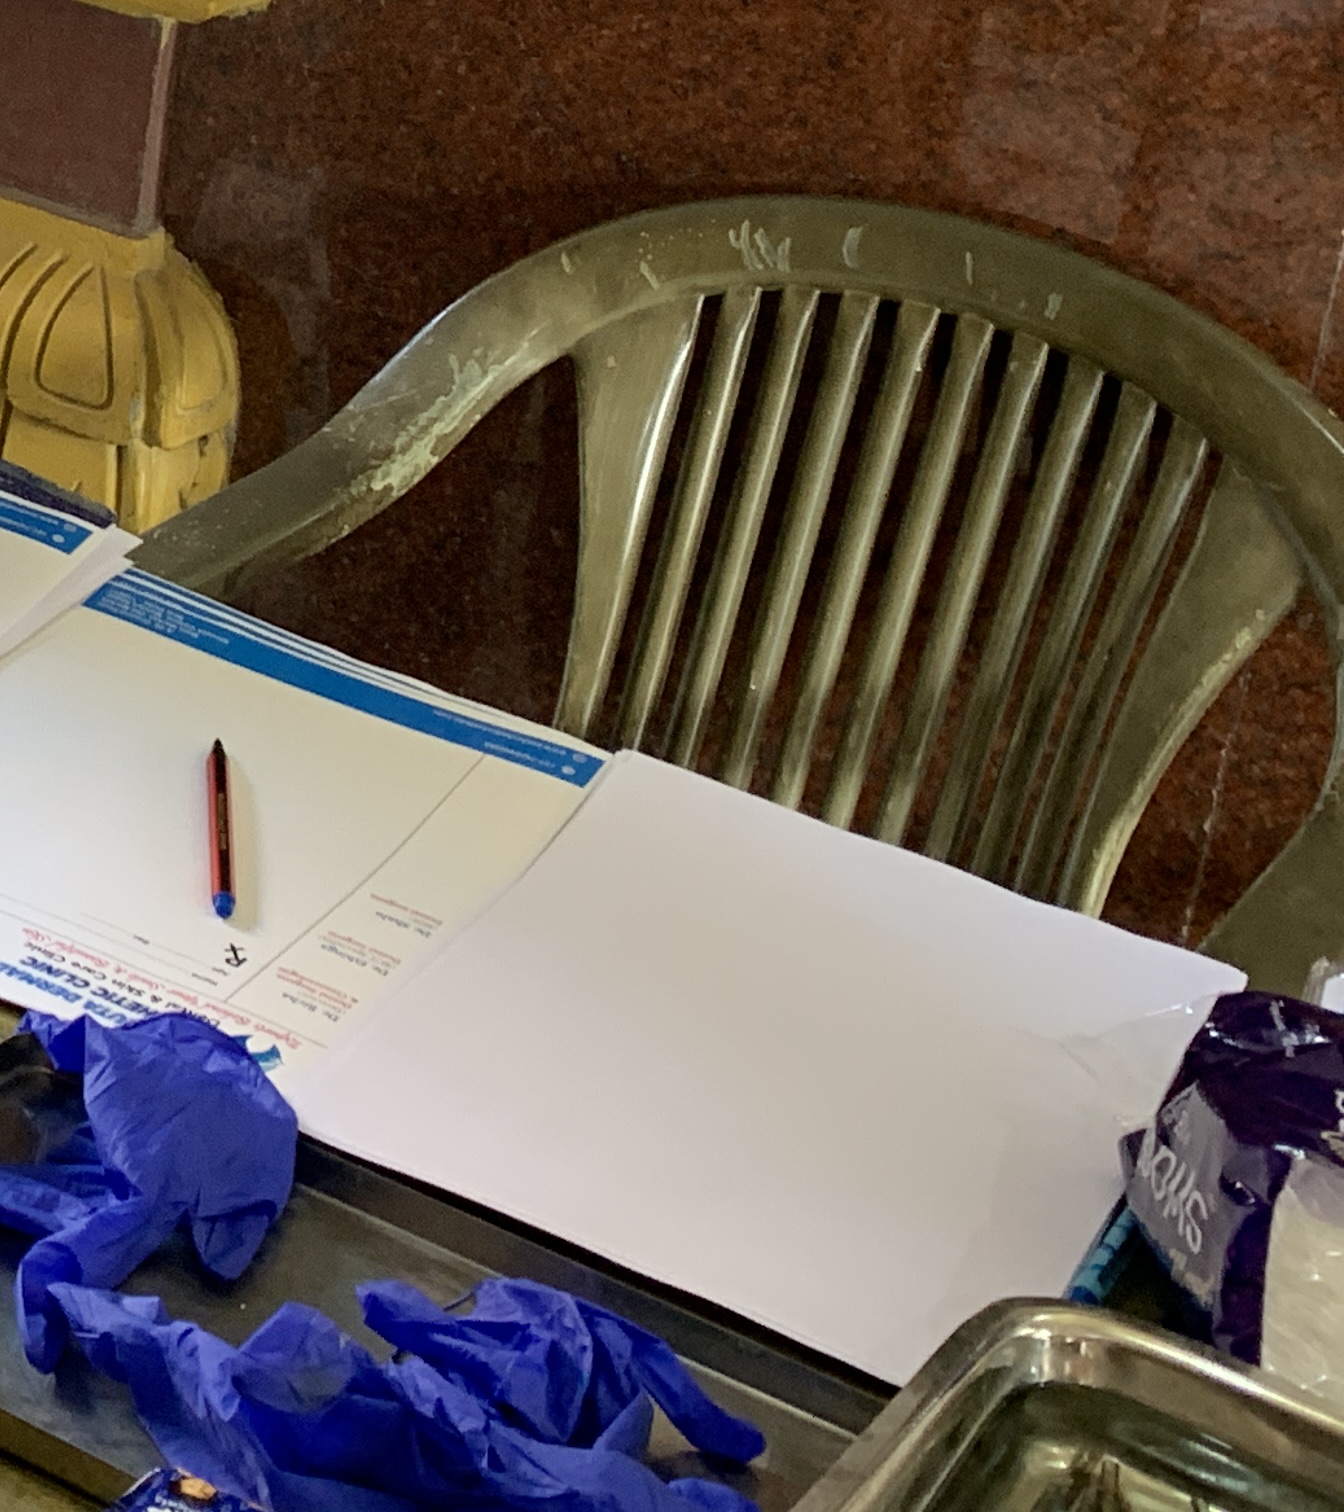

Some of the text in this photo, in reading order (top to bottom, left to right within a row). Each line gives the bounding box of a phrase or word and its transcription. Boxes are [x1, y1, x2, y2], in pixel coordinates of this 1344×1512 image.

[23, 940, 66, 962] Clinic
[19, 954, 91, 989] CLINIC
[68, 960, 107, 981] Care
[109, 978, 145, 997] Skin
